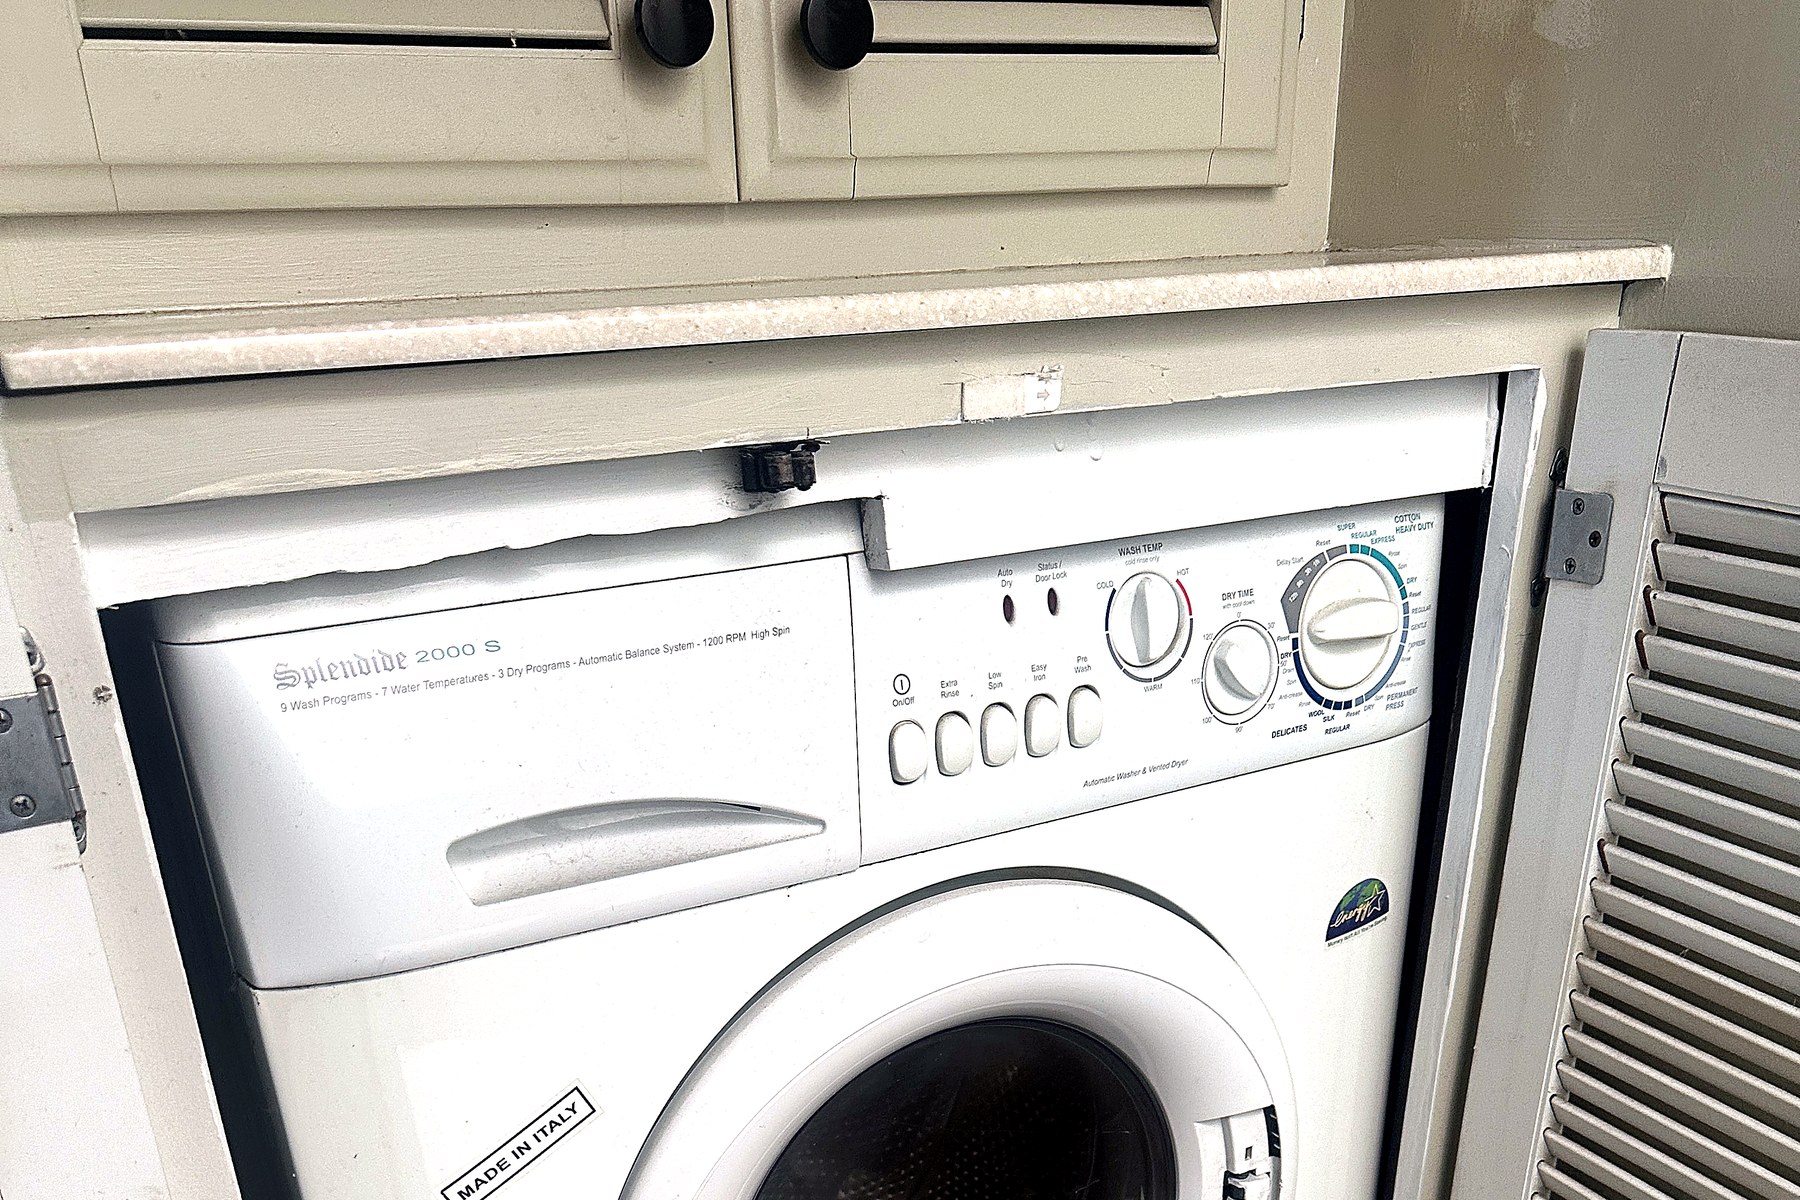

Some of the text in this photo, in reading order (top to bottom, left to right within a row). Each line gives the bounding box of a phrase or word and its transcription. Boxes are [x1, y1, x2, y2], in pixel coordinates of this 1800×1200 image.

[1394, 513, 1421, 523] COTTON
[1337, 522, 1356, 531] SUPER
[1395, 521, 1434, 534] HEAVY DUTY
[1351, 530, 1377, 539] REGULAR
[1371, 535, 1396, 544] EXPRESS
[1118, 542, 1163, 556] WASH TEMP
[1037, 562, 1058, 571] Status
[997, 568, 1014, 577] Auto
[1035, 570, 1067, 582] Door Lock
[1176, 568, 1189, 576] HOT
[1001, 580, 1013, 588] Dry
[1096, 580, 1114, 589] COLD
[1222, 588, 1254, 601] DRY TIME
[1076, 655, 1088, 663] Pre
[1280, 651, 1293, 660] DRY
[273, 640, 501, 690] Splendide 2000 S
[280, 702, 288, 713] 9
[290, 698, 320, 711] Wash
[323, 691, 372, 706] Programs
[381, 686, 387, 696] 7
[391, 682, 420, 695] Water
[423, 673, 489, 689] Temperatures
[498, 669, 504, 678] 3
[507, 667, 523, 678] Dry
[526, 659, 571, 674] Programs
[578, 651, 623, 666] Automatic
[625, 646, 661, 660] Balance
[663, 640, 695, 654] System
[703, 636, 723, 647] 1200
[726, 632, 747, 643] RPM
[751, 628, 770, 641] High
[772, 625, 790, 638] Spin
[1031, 664, 1047, 672] Easy
[1074, 664, 1092, 674] Wash
[988, 672, 1002, 680] Low
[940, 680, 958, 688] Extra
[988, 681, 1003, 690] Spin
[1143, 683, 1163, 693] WARM
[940, 690, 960, 698] Rinse
[892, 696, 915, 707] On/Off
[1385, 700, 1404, 711] PRESS
[1308, 709, 1325, 718] WOOL
[1322, 714, 1335, 722] SILK
[1271, 724, 1308, 738] DELICATES
[1324, 724, 1350, 735] REGULAR
[1083, 759, 1189, 788] Automatic Washer & Vented Dryer
[457, 1101, 578, 1200] MADE IN ITALY
